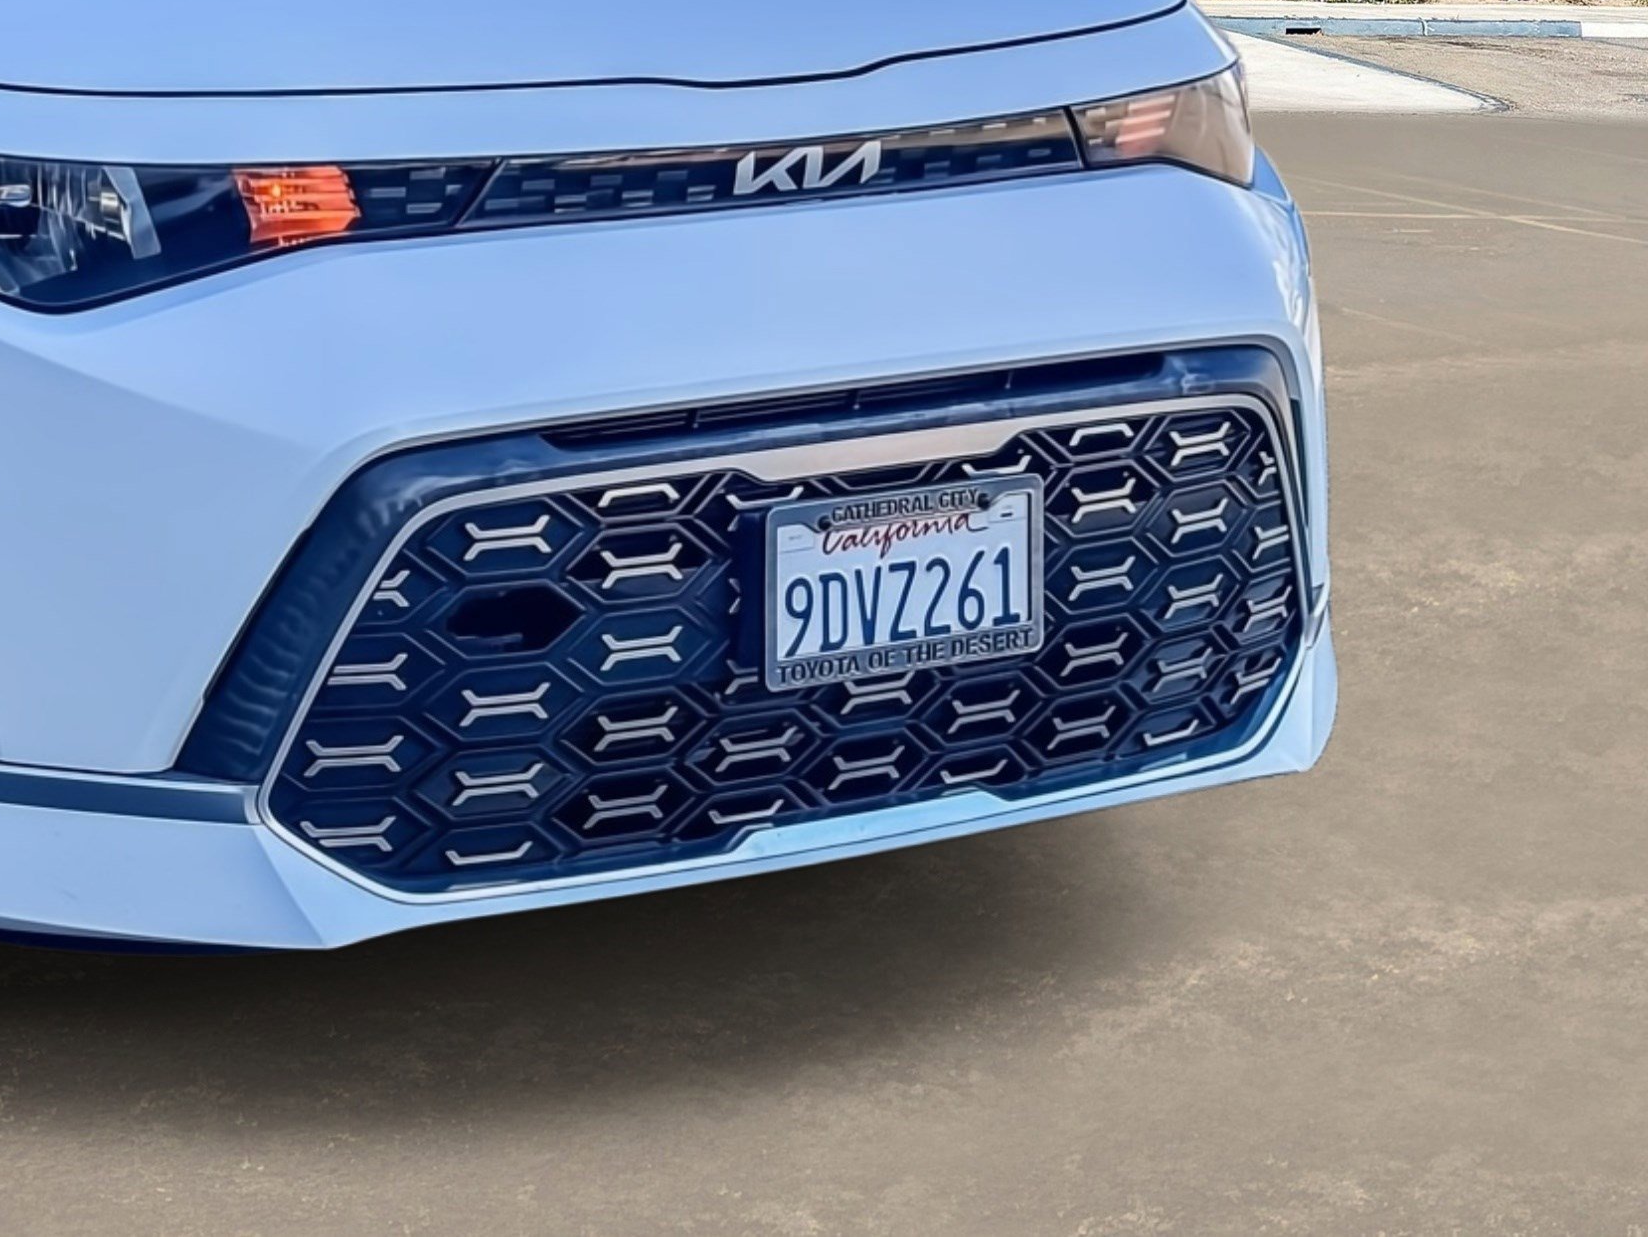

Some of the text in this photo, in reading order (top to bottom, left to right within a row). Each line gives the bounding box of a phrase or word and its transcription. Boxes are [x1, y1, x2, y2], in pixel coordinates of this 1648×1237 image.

[831, 488, 979, 523] CATHEDRAL CITY
[821, 513, 989, 558] California
[783, 546, 1021, 659] 9DVZ261
[777, 628, 1034, 684] TOYOTA OF THE DESERT
